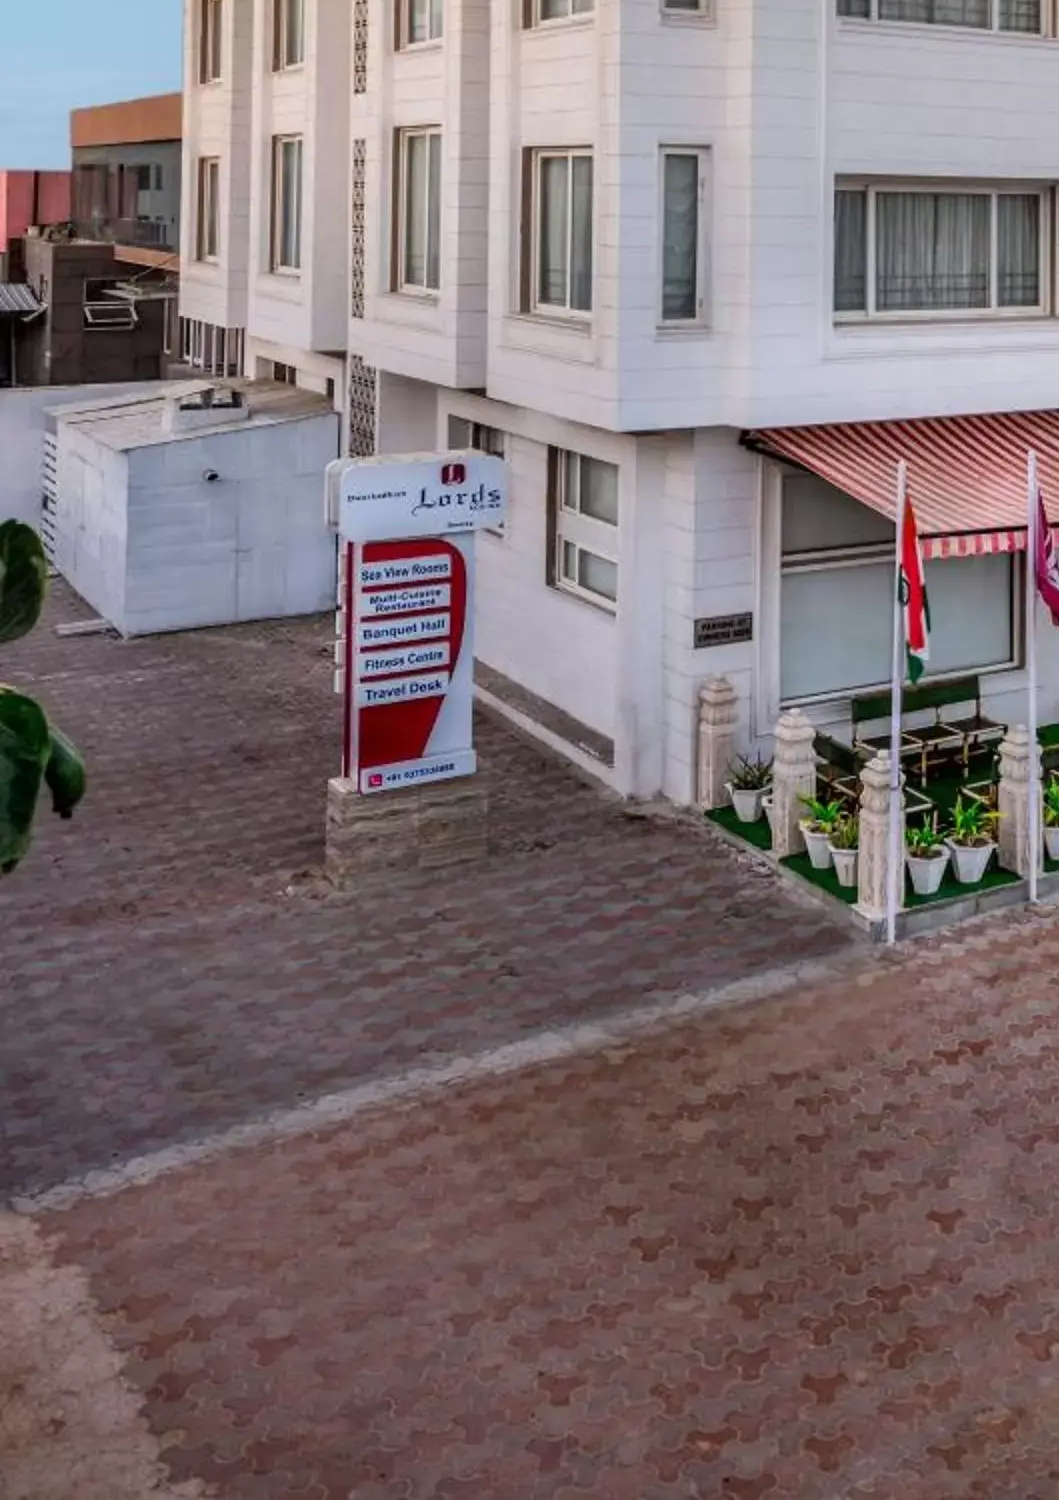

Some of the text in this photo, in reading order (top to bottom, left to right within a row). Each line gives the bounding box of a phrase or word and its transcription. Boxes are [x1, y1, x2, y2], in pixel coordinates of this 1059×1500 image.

[411, 484, 501, 516] Lords
[361, 563, 449, 582] Sea View Rooms
[375, 598, 436, 613] Restaurant
[363, 619, 445, 641] Banquet Hall
[365, 651, 444, 672] Fitness Centre
[365, 679, 442, 701] Travel Desk
